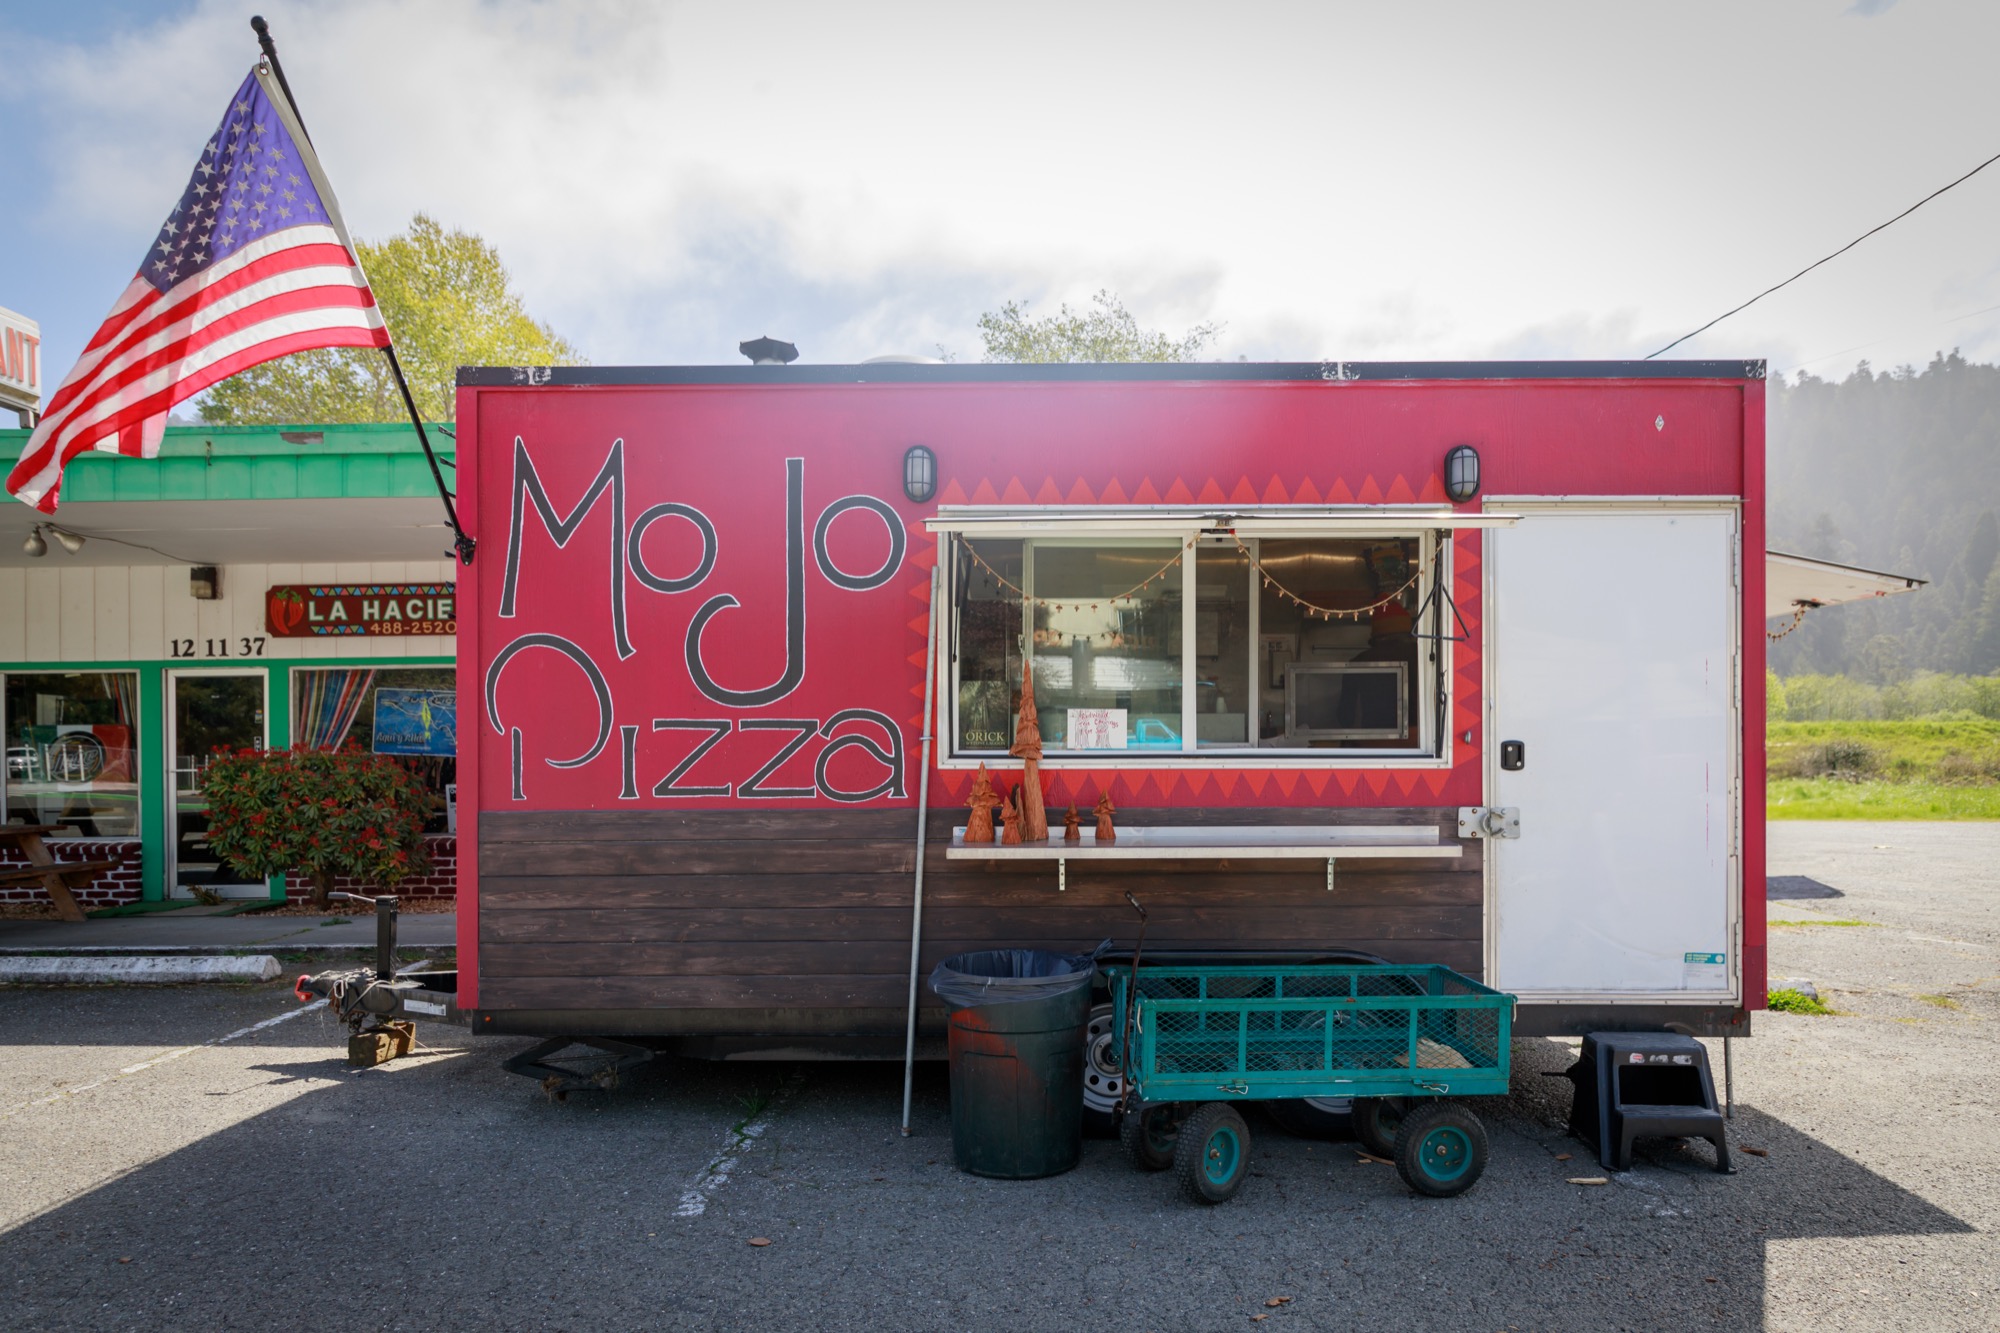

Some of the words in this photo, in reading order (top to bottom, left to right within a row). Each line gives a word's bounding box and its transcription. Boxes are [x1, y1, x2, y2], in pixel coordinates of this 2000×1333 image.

[309, 600, 348, 621] LA
[370, 620, 457, 634] 488-2520
[171, 638, 196, 658] 12
[205, 638, 229, 657] 11
[239, 636, 266, 657] 37
[485, 632, 908, 803] Pizza
[965, 731, 1005, 742] ORICK
